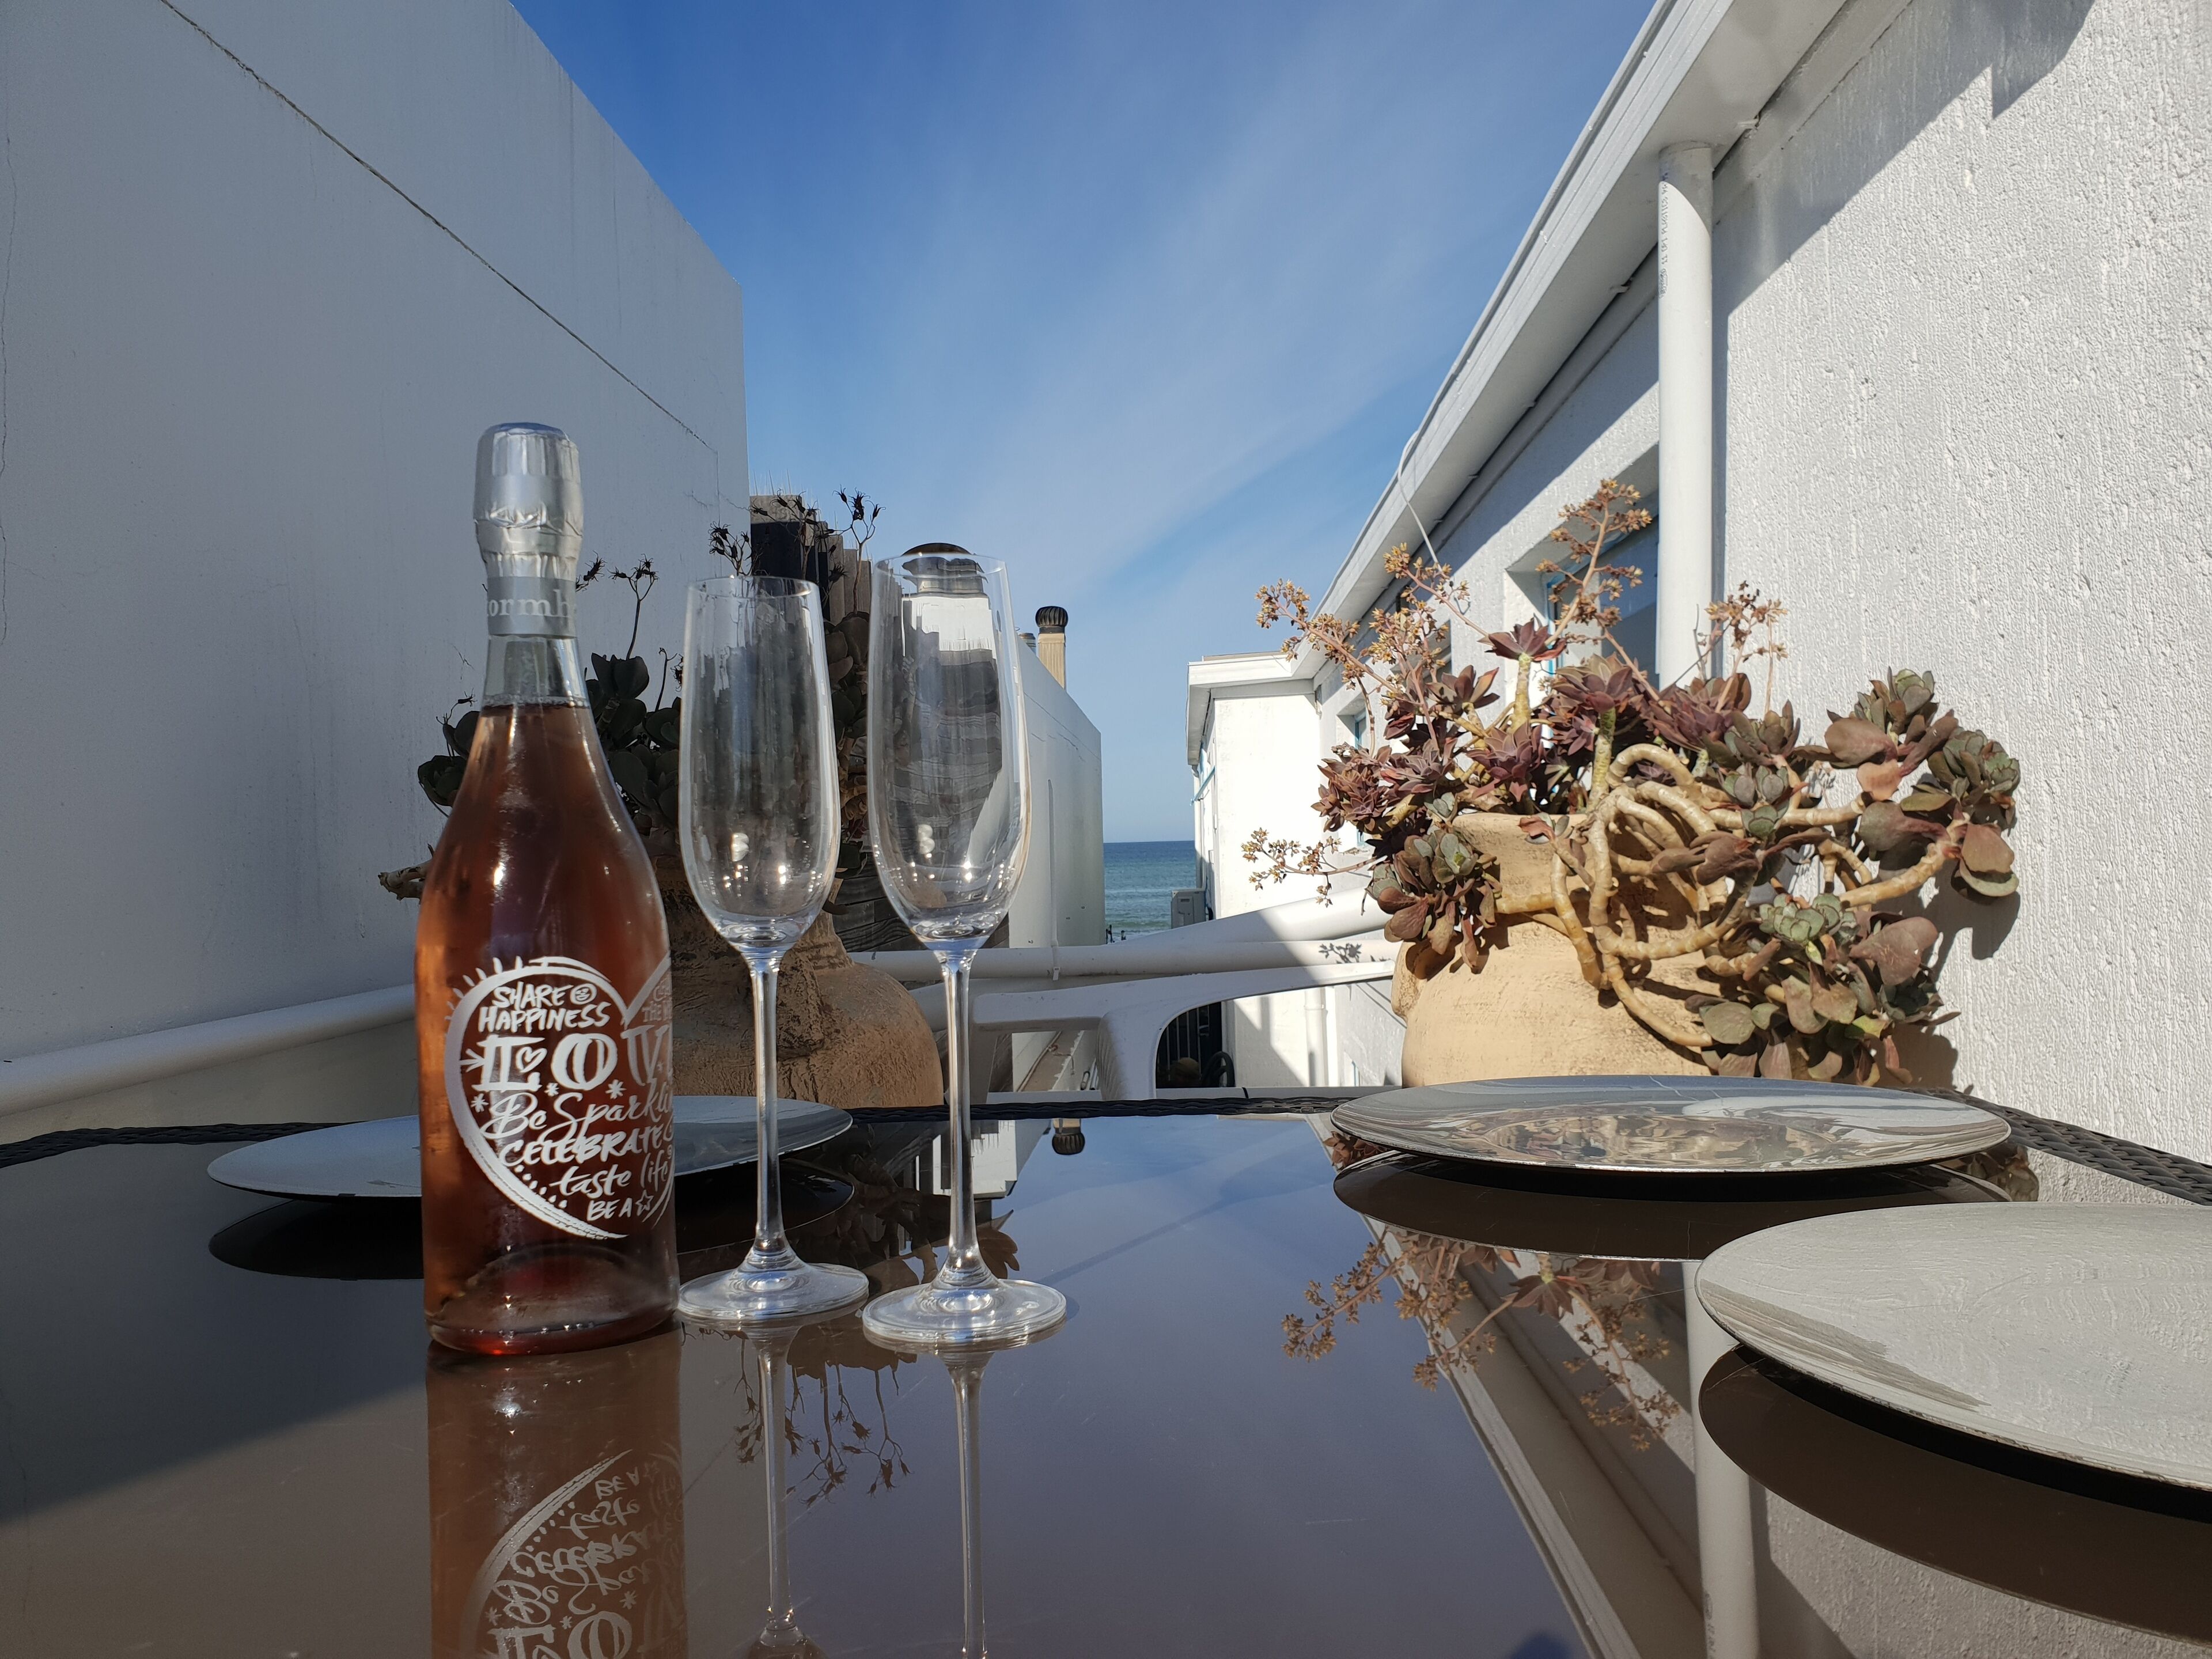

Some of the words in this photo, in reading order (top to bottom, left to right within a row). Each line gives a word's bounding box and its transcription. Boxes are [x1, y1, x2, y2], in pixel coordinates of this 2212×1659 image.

[492, 981, 574, 1010] SHARE
[478, 1001, 612, 1033] HAPPINESS
[479, 1092, 548, 1139] Be
[498, 1124, 664, 1167] CELEBRATE
[549, 1164, 632, 1199] taste
[639, 1150, 668, 1191] life
[586, 1199, 620, 1221] BE
[618, 1197, 632, 1218] A
